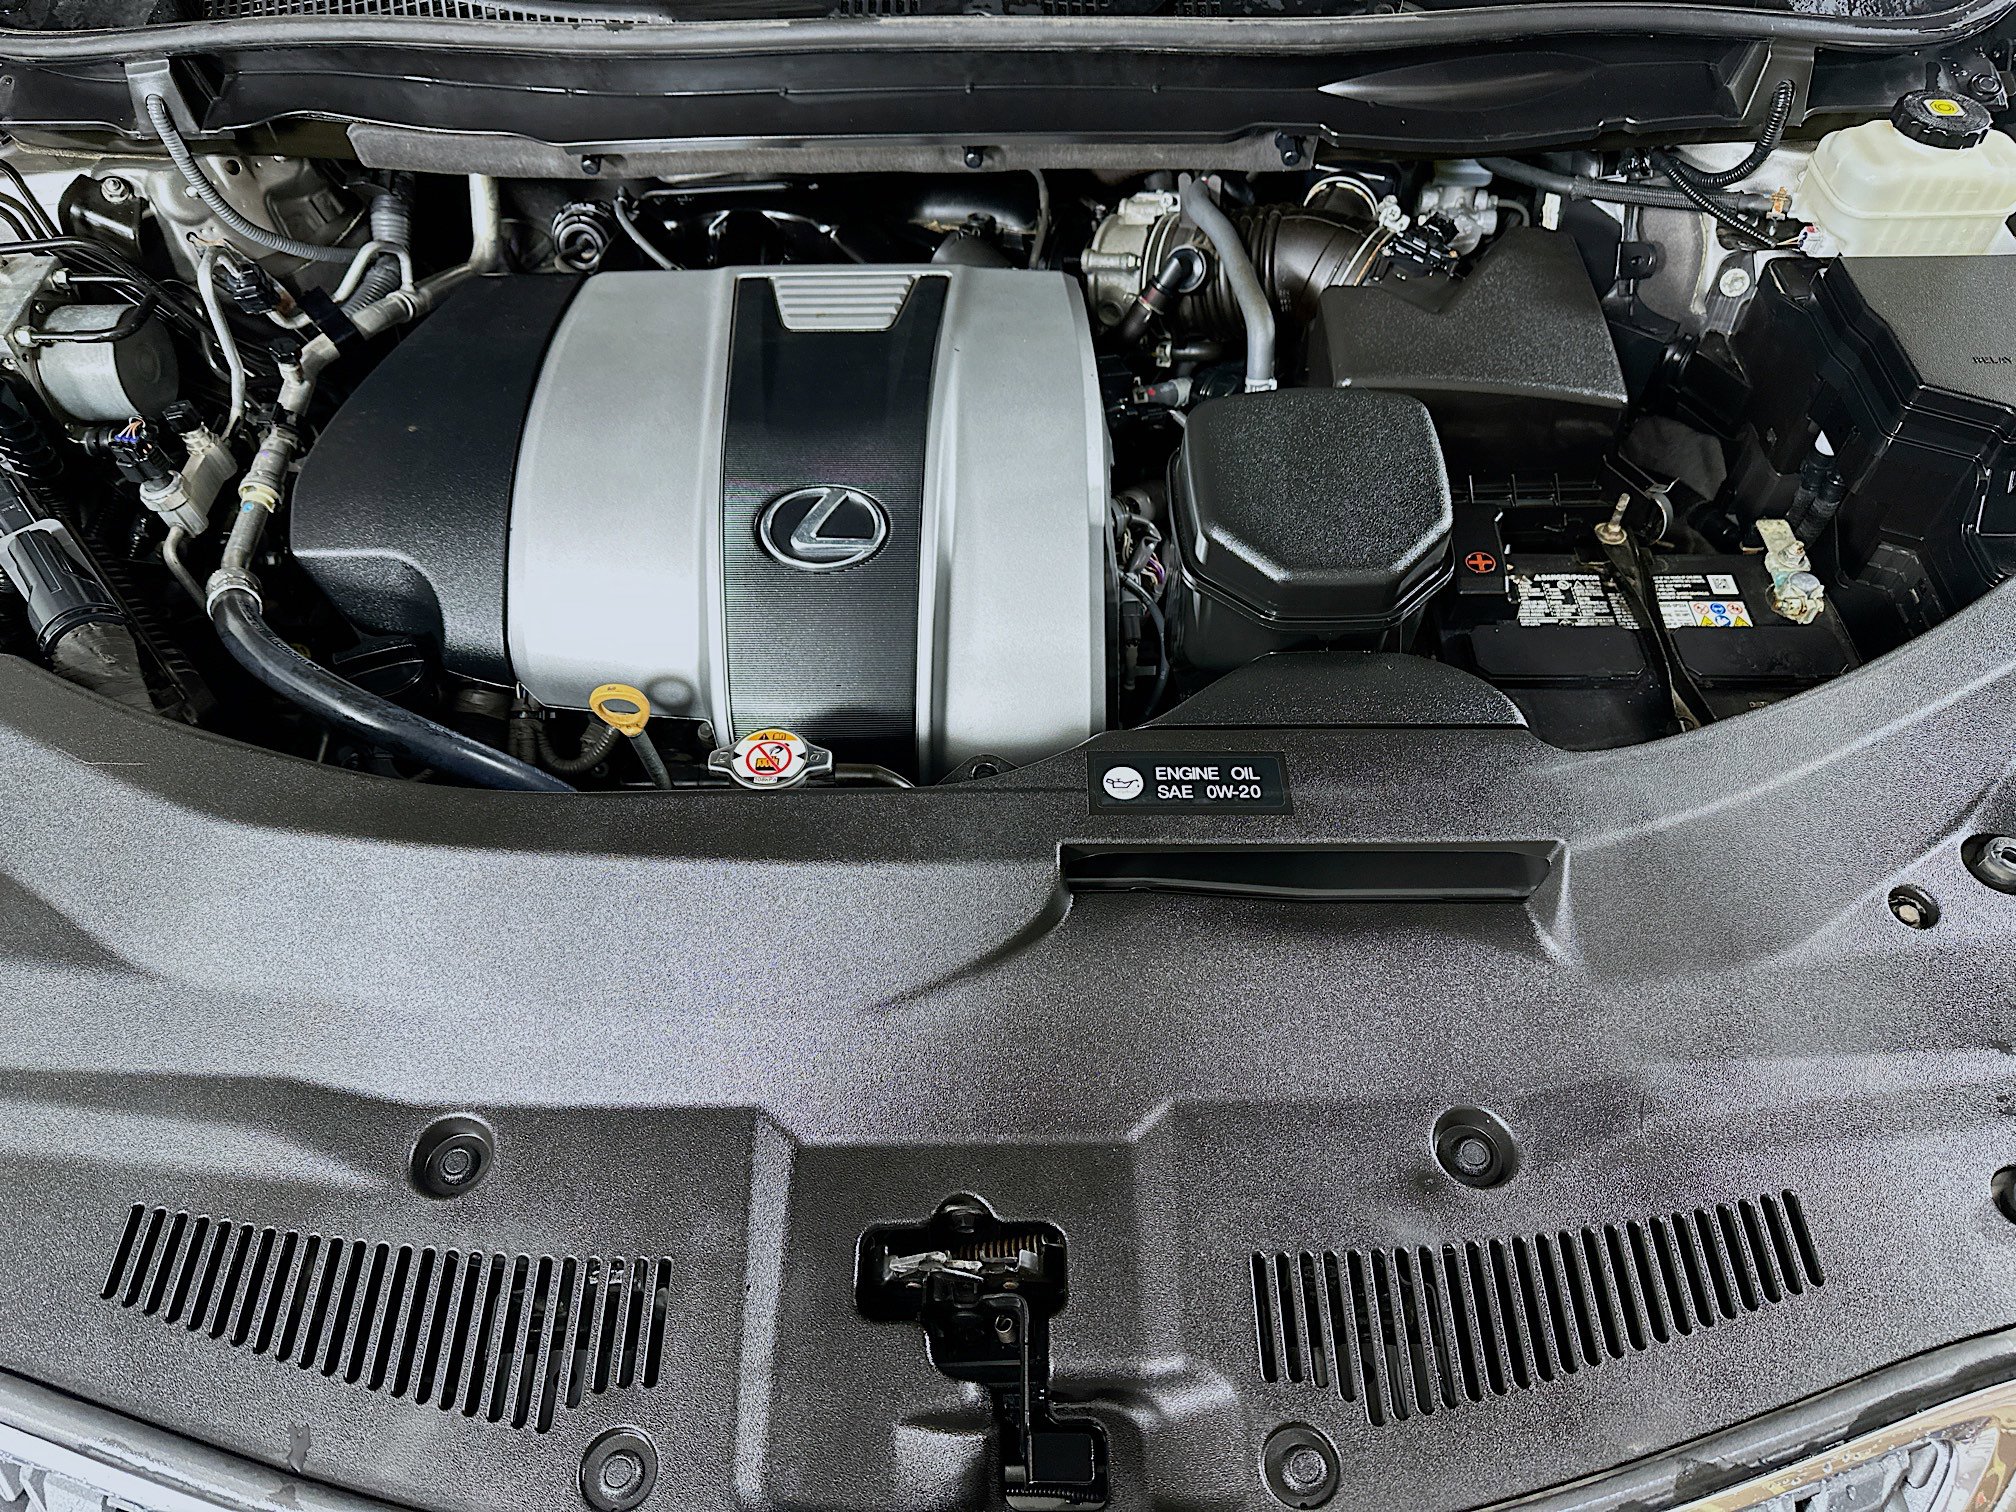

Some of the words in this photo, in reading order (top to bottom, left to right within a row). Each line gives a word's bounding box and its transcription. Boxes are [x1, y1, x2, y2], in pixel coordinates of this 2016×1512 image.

[1972, 356, 2013, 364] RELAY
[1155, 766, 1220, 781] ENGINE
[1230, 766, 1261, 781] OIL
[1157, 785, 1194, 799] SAE
[1206, 785, 1262, 799] 0W-20
